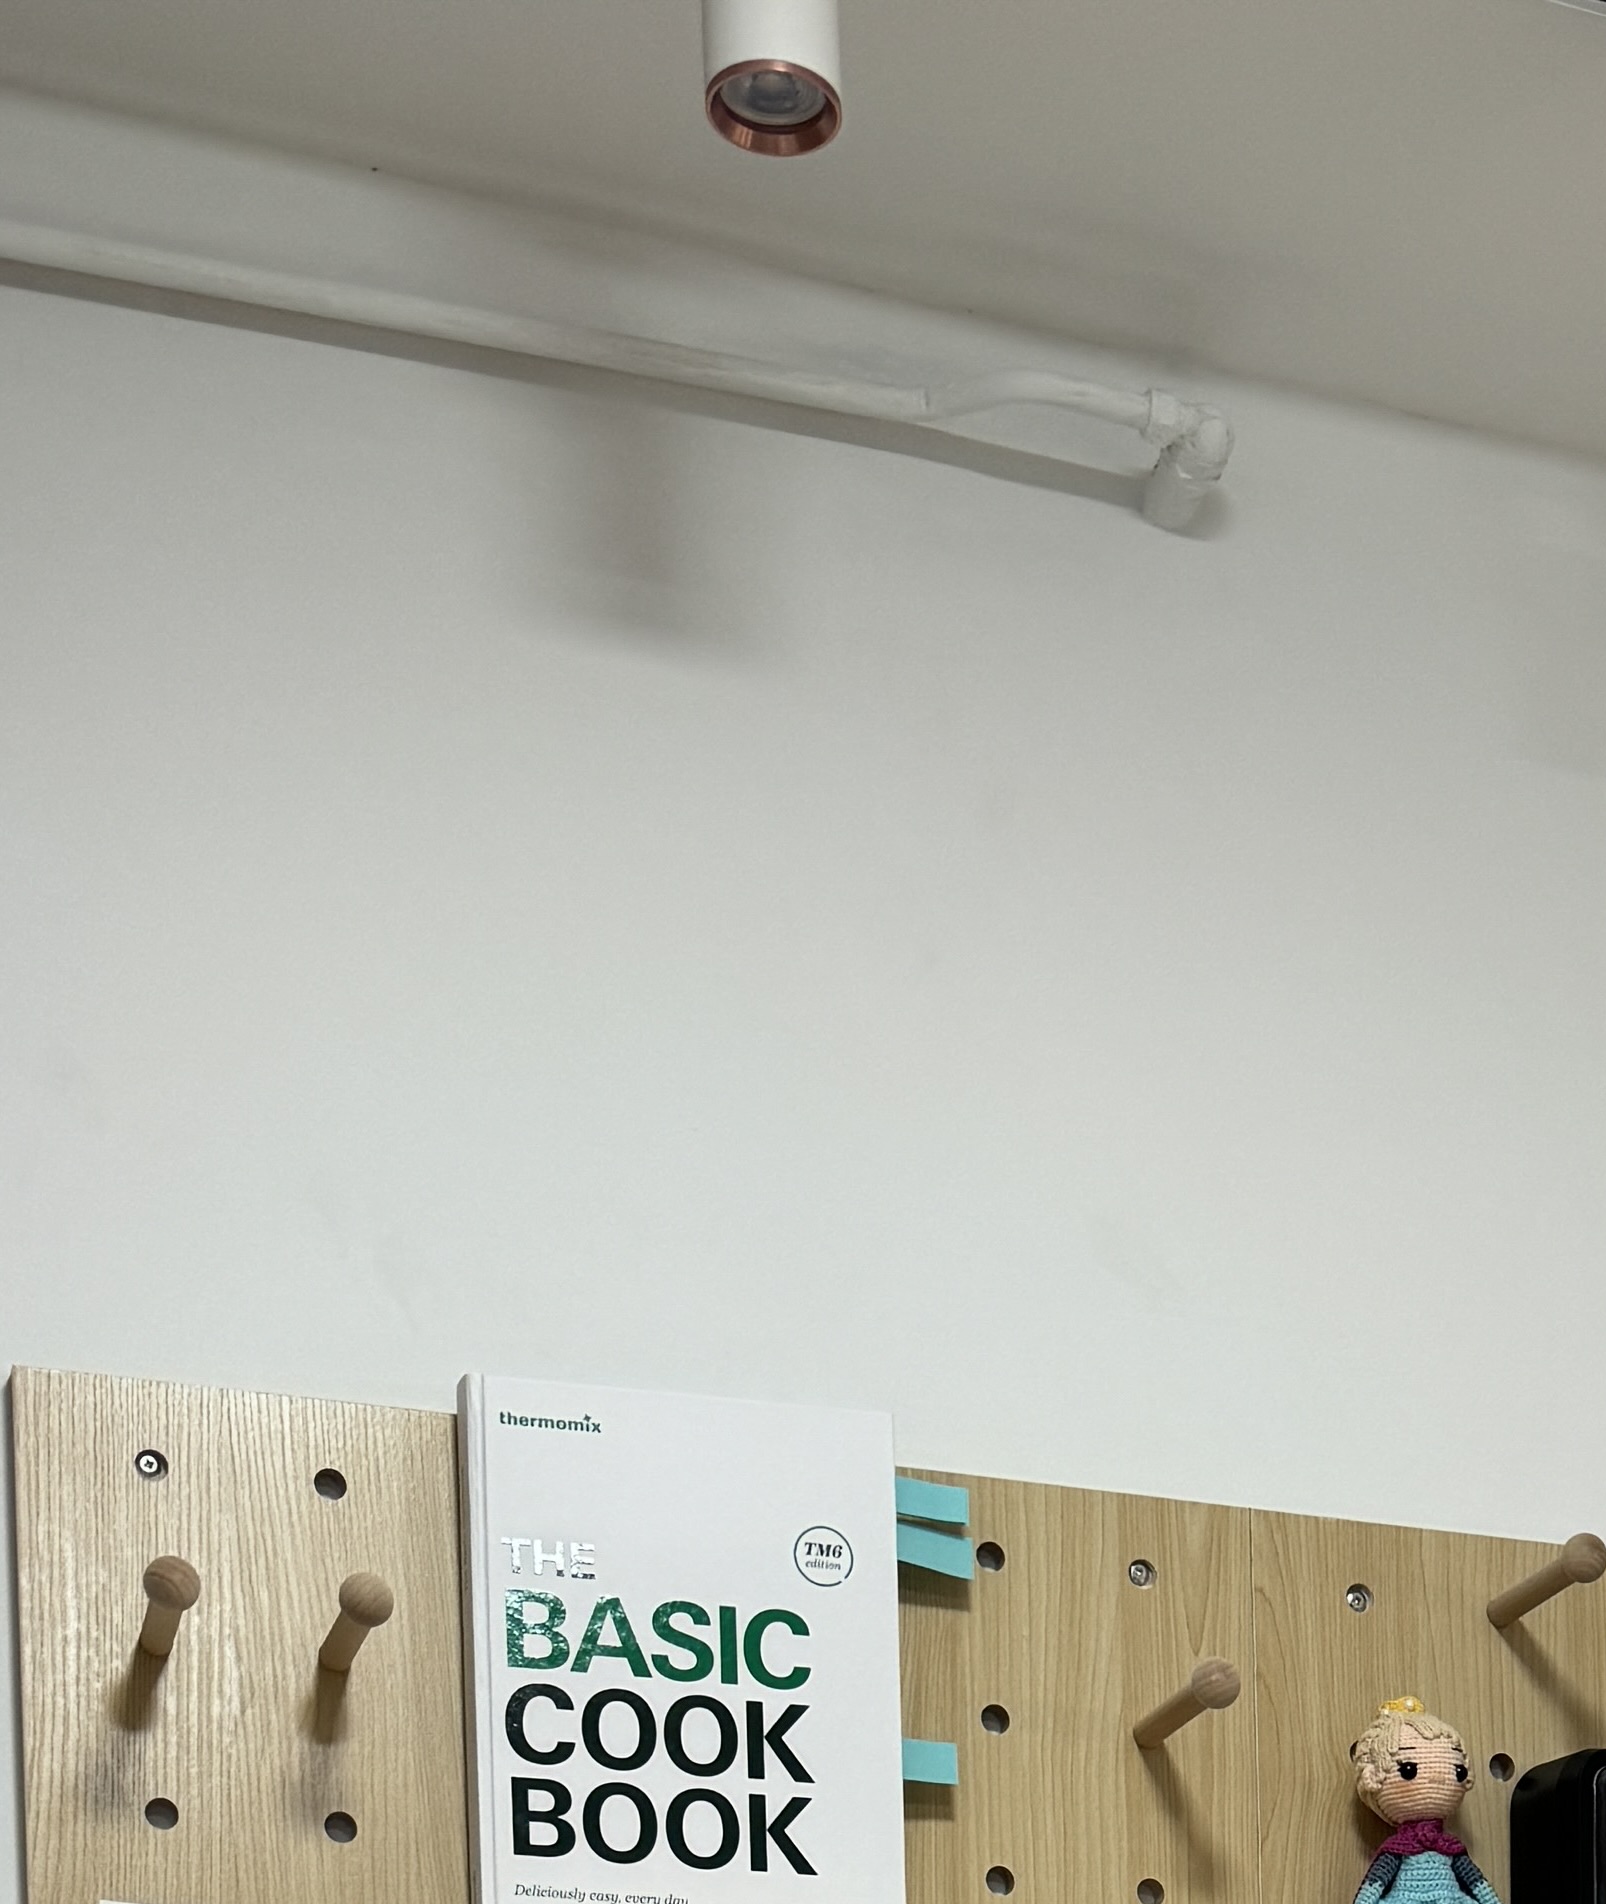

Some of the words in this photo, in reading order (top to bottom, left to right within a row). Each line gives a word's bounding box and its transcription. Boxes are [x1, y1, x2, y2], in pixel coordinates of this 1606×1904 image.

[499, 1411, 602, 1434] thermomix
[500, 1536, 597, 1581] THE
[804, 1542, 843, 1559] TM6
[804, 1558, 842, 1572] edition
[505, 1587, 811, 1690] BASIC
[505, 1683, 815, 1784] COOK
[511, 1776, 819, 1876] BOOK
[514, 1883, 587, 1904] Deliciously
